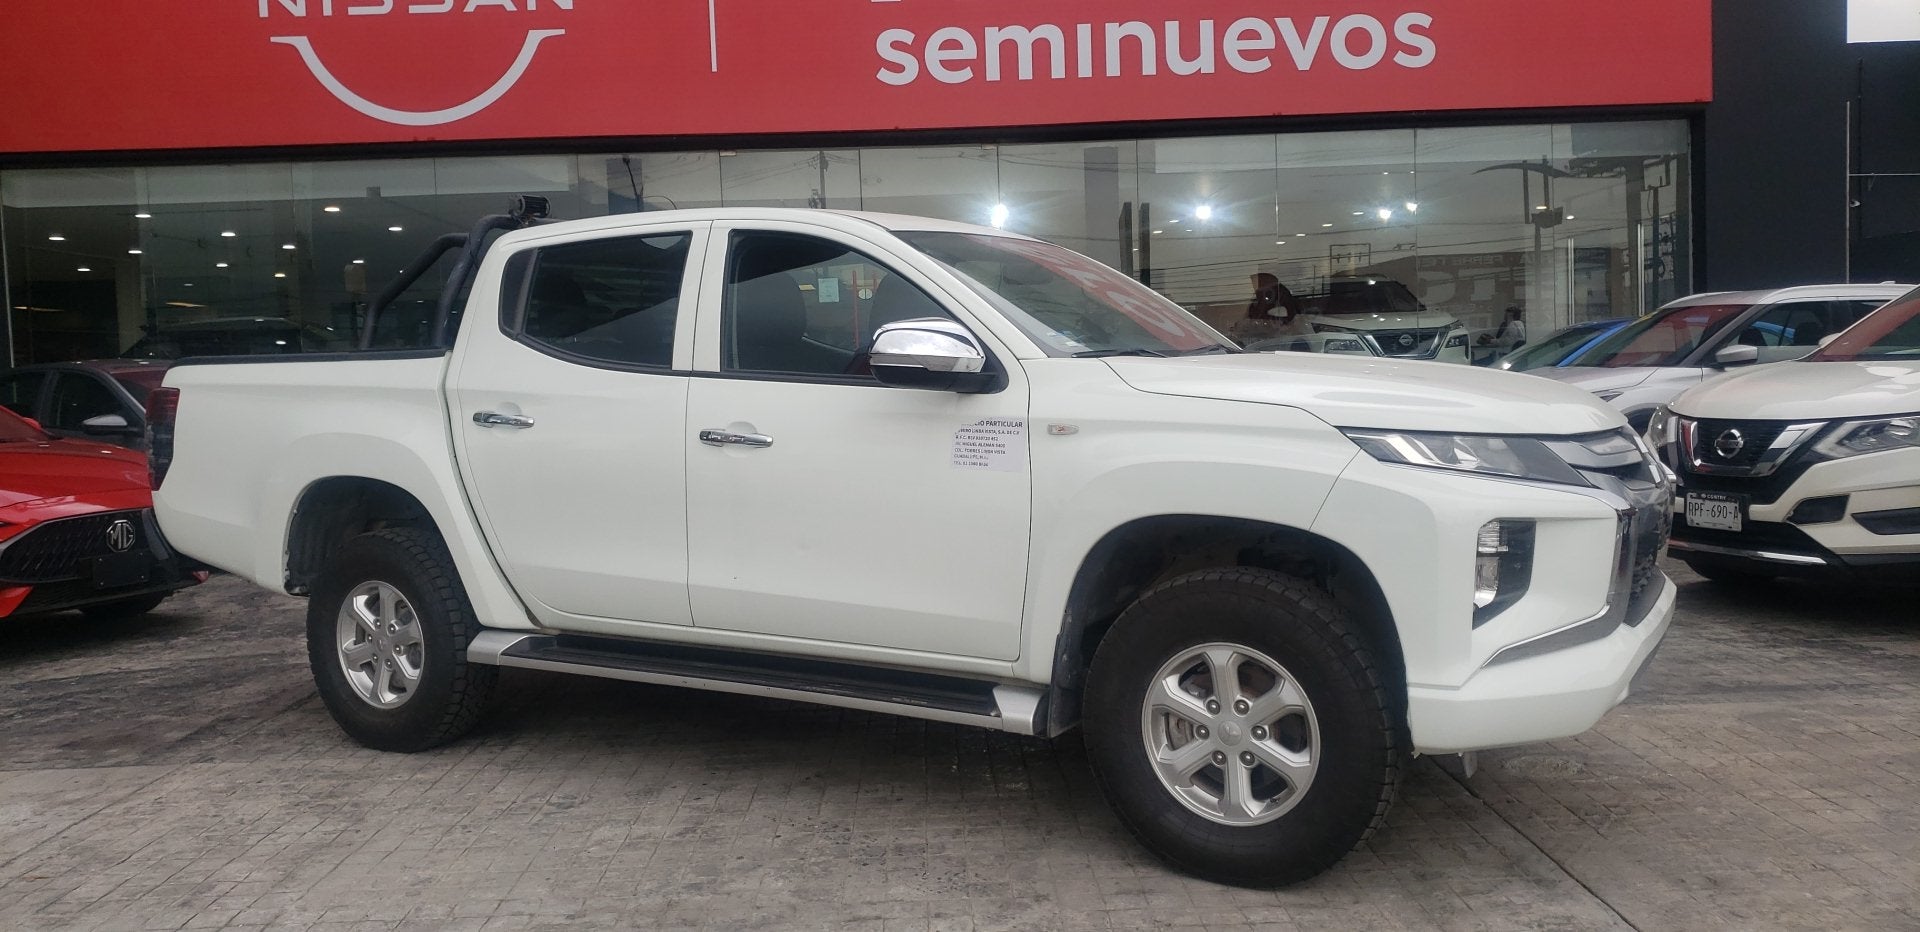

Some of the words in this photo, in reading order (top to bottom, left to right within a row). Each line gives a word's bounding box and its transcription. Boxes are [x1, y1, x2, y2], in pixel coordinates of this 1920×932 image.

[876, 13, 1436, 86] seminuevos
[985, 420, 1023, 428] PARTICULAR
[110, 523, 134, 550] MG
